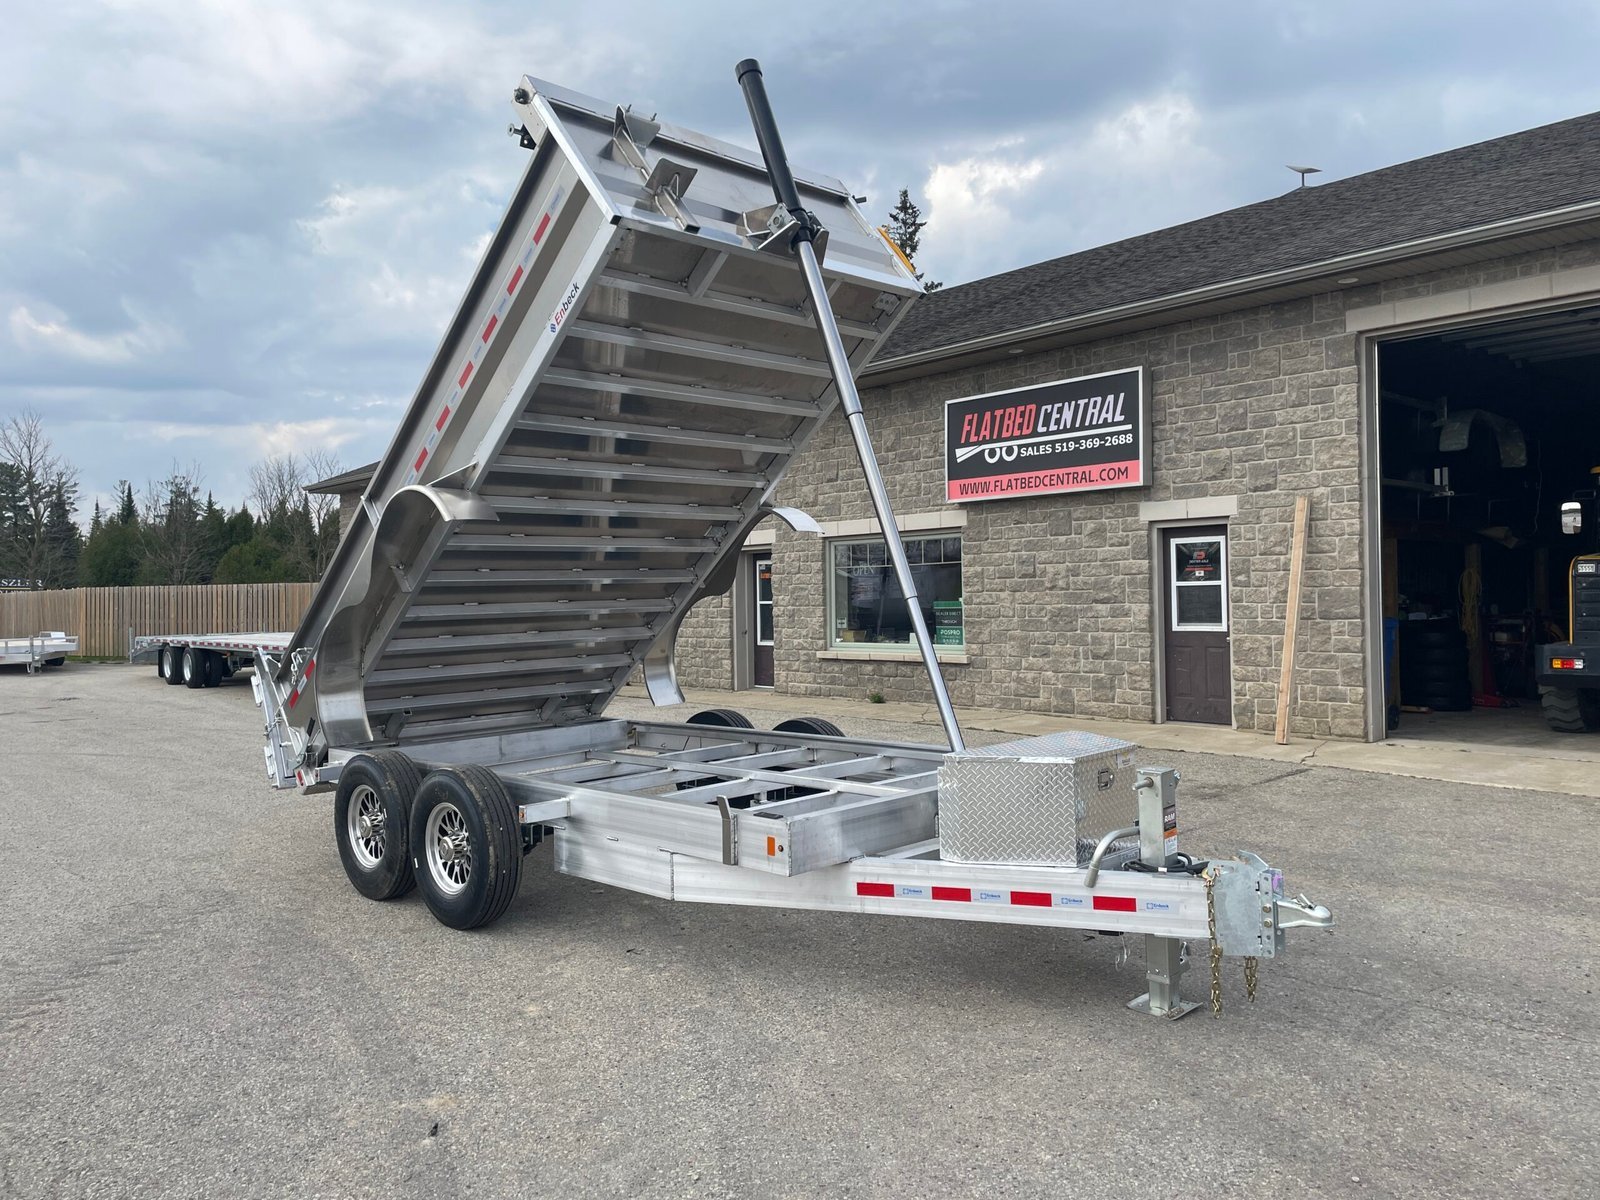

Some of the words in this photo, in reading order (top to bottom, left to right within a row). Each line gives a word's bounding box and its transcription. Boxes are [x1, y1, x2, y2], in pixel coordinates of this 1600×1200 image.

[554, 282, 579, 326] Enbeck
[960, 404, 1037, 444] FLATBED
[1036, 392, 1126, 433] CENTRAL
[1020, 444, 1052, 457] SALES
[1055, 433, 1133, 453] 519-369-2688
[959, 466, 1129, 496] WWW.FLATBEDCENTRAL.COM
